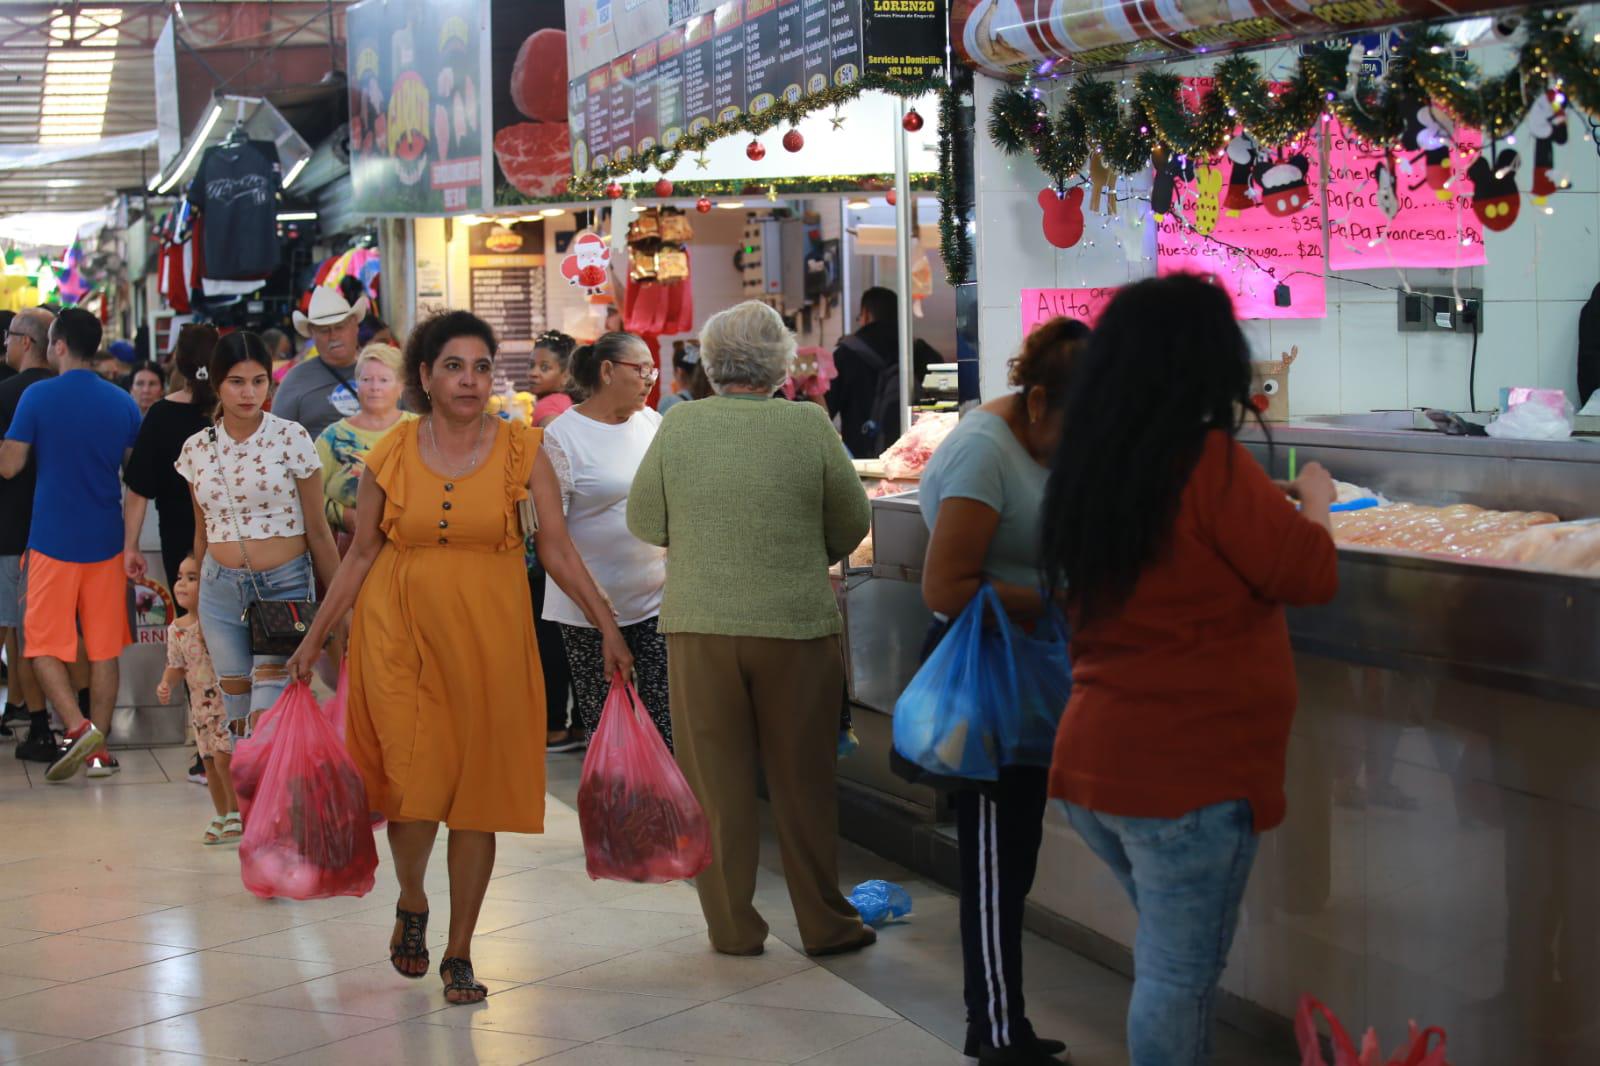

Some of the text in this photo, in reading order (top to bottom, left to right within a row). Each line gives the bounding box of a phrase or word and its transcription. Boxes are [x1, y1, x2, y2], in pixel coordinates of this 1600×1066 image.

[874, 0, 935, 11] LORENZO
[868, 56, 898, 64] Servicio
[903, 67, 912, 75] 40
[914, 67, 923, 75] 34
[1157, 243, 1198, 257] Hueso
